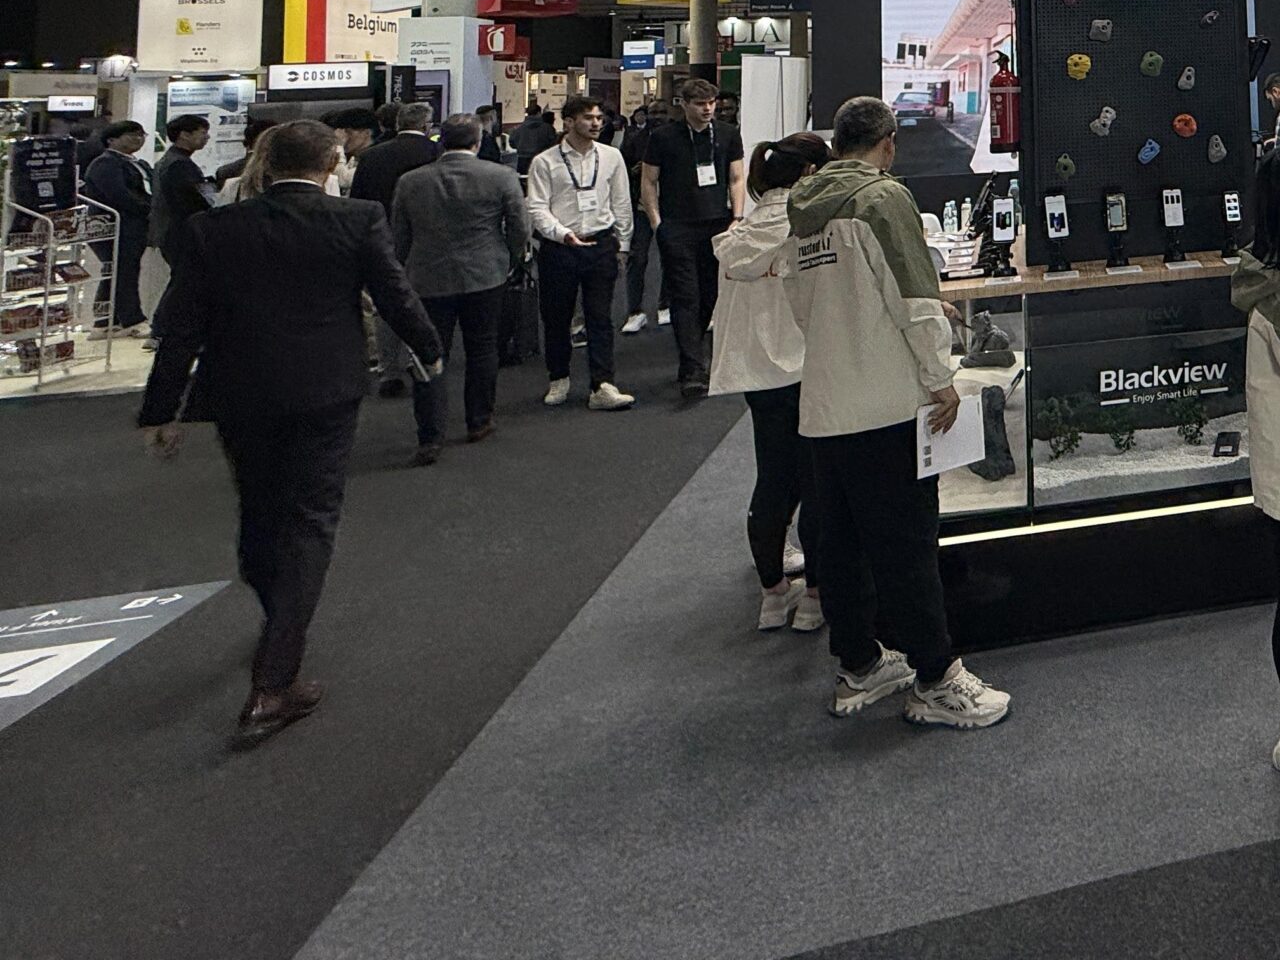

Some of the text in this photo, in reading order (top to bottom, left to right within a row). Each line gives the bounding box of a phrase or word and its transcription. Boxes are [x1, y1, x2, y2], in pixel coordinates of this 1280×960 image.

[347, 13, 398, 35] Belgium
[672, 22, 783, 45] ILIA
[303, 69, 352, 82] COSMOS
[1100, 362, 1228, 393] Blackview
[1132, 388, 1198, 404] Enjoy Smart Life
